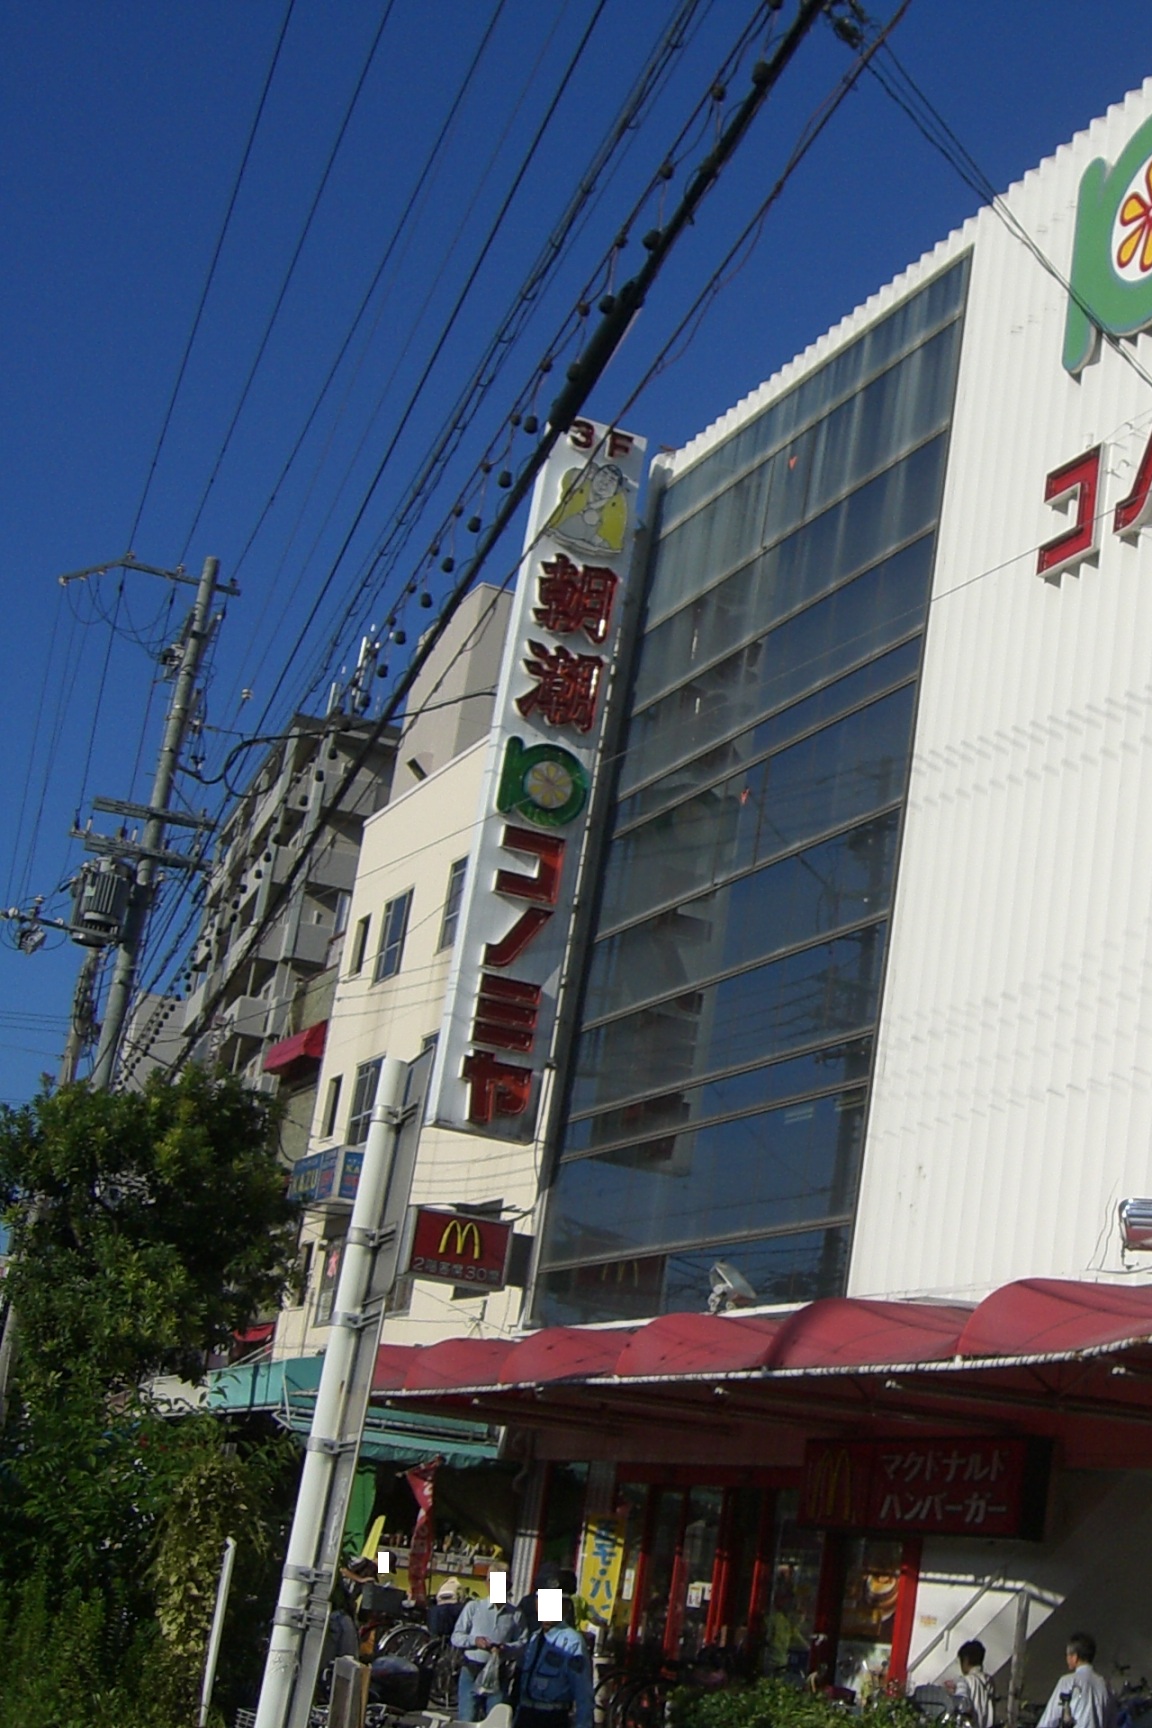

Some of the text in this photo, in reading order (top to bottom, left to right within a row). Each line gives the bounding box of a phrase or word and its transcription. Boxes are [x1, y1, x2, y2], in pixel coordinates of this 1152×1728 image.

[566, 419, 635, 460] 3F
[459, 825, 567, 1125] コノミヤ
[882, 1449, 1009, 1483] マクドナルド
[879, 1491, 1008, 1524] ハンバーガー
